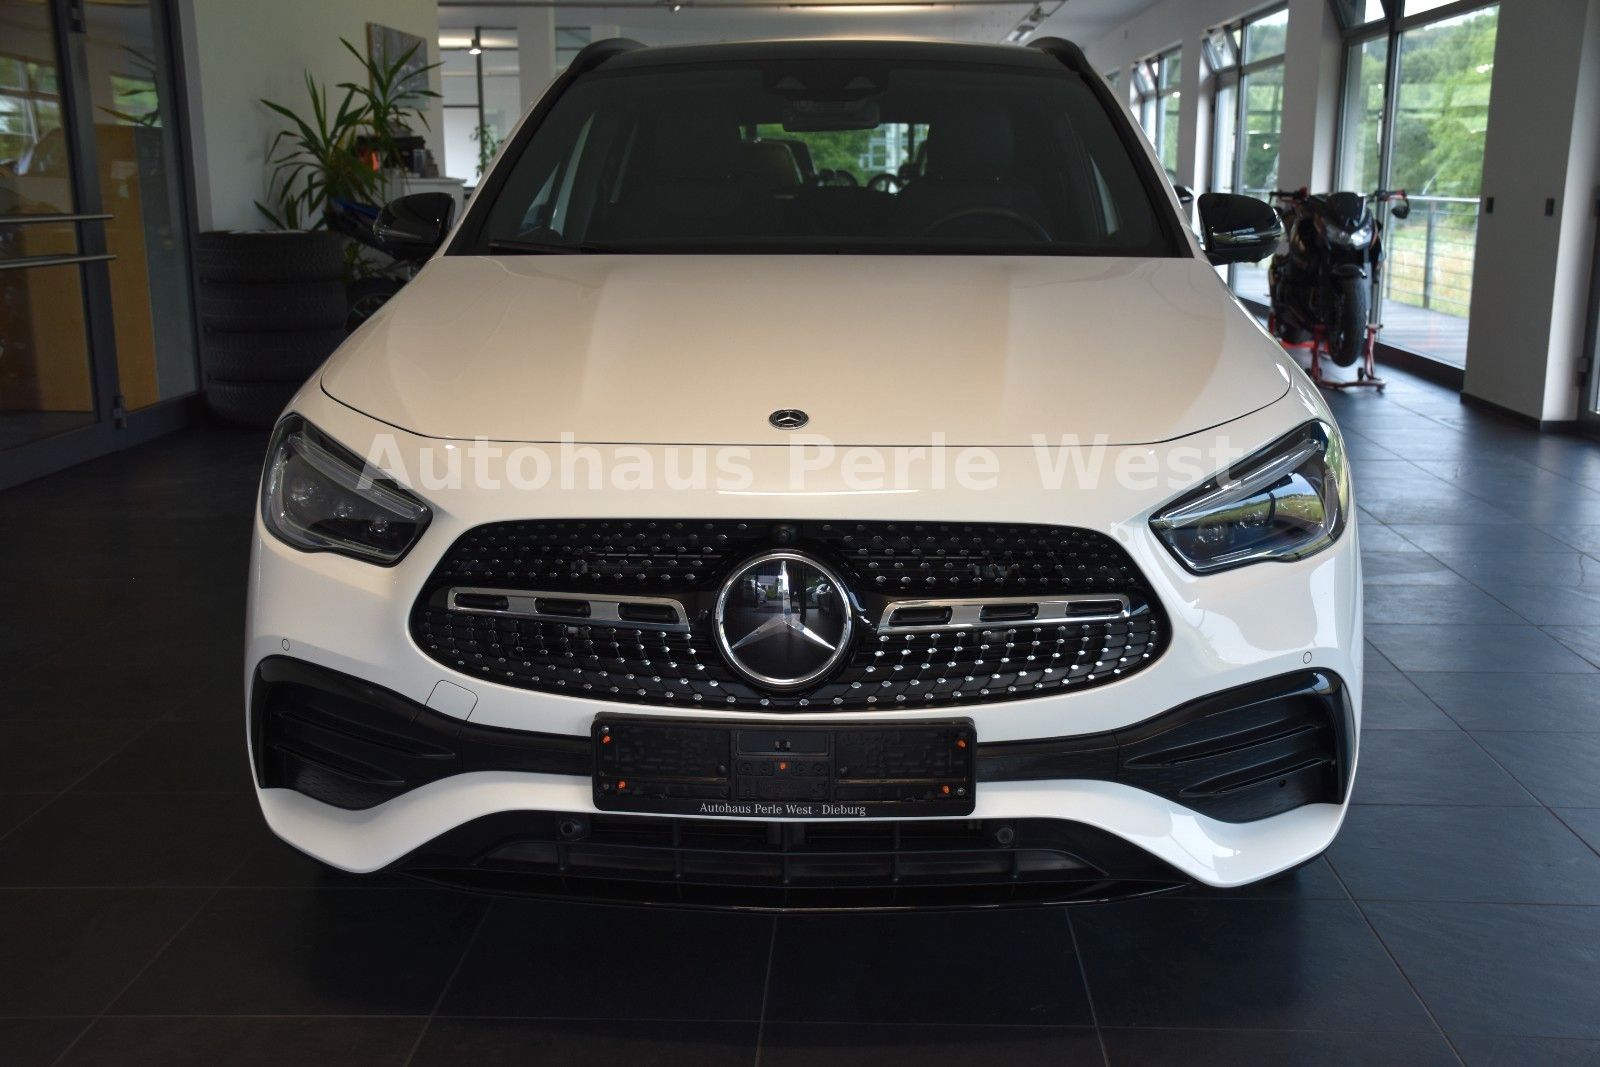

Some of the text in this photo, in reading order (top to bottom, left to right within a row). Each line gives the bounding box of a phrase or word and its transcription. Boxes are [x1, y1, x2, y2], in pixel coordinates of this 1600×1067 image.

[699, 802, 867, 816] Autohaus Perle West Dieburg
